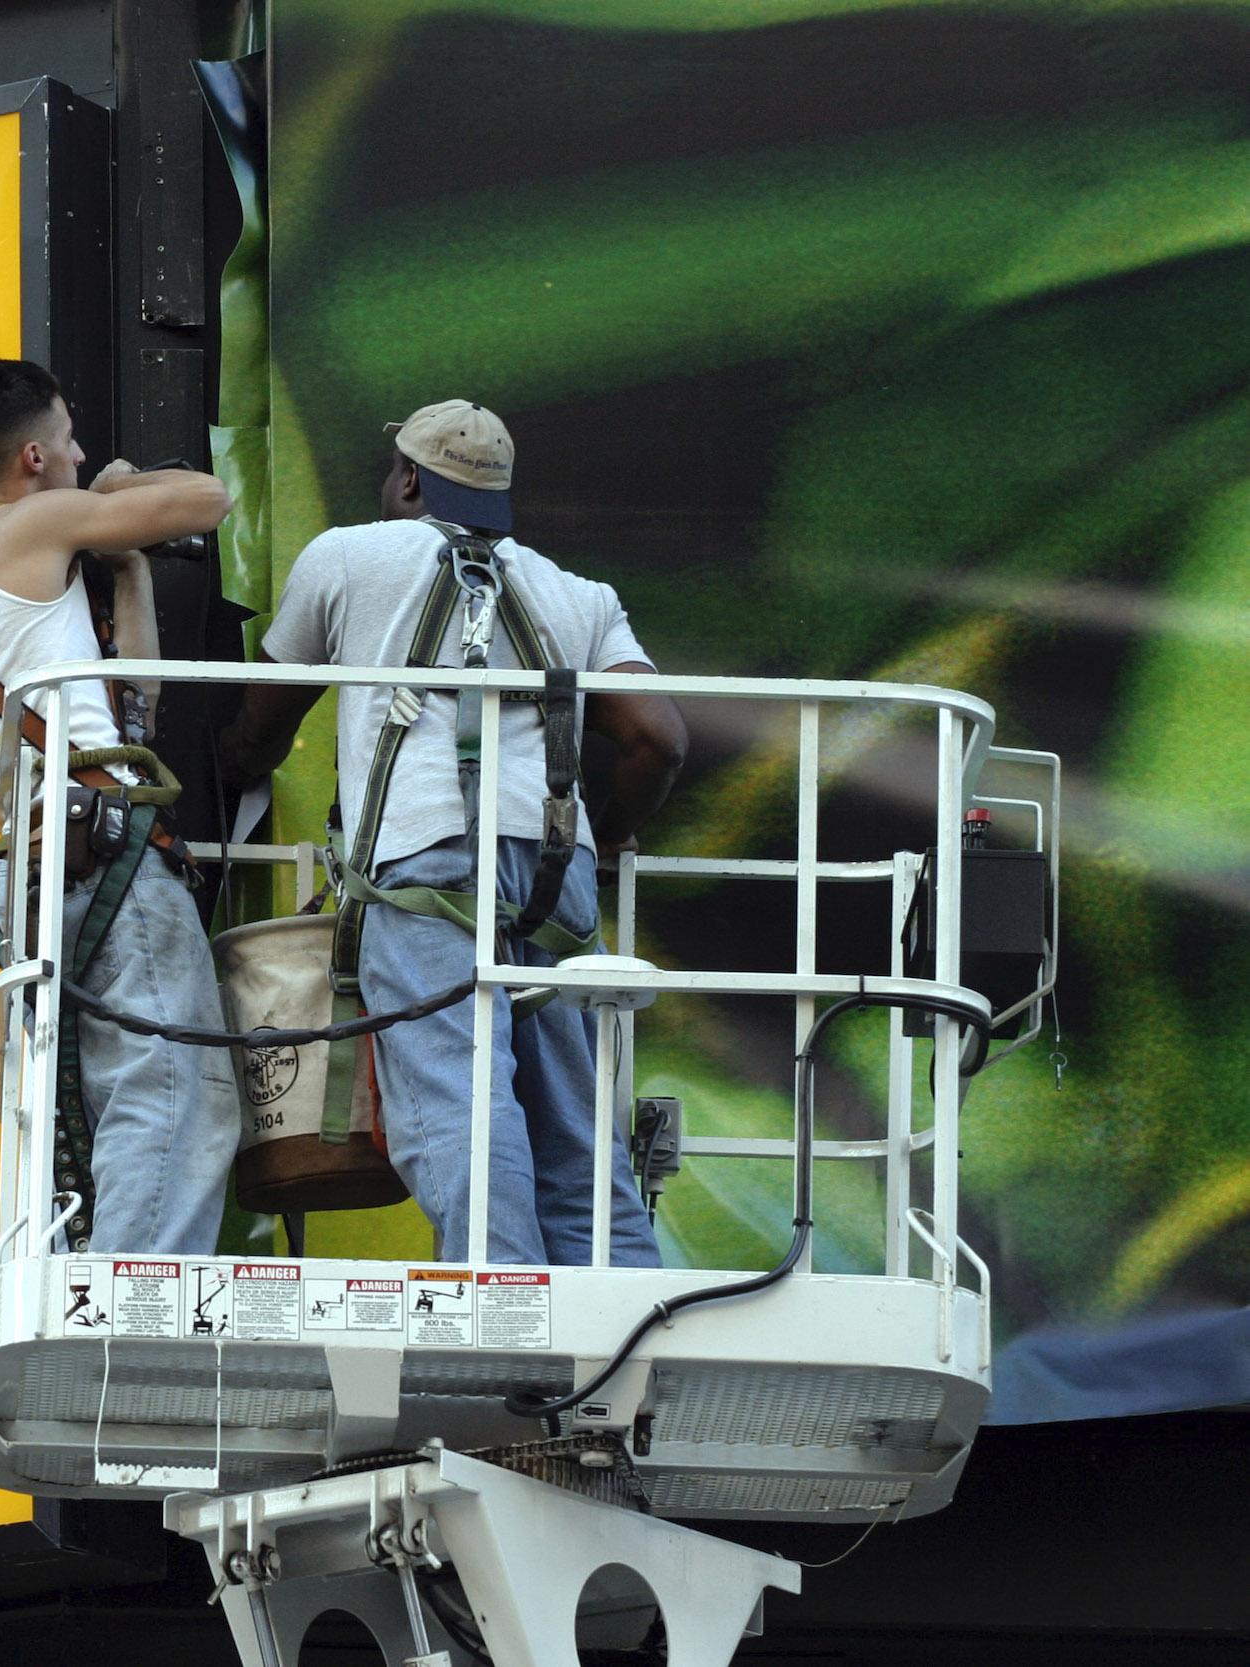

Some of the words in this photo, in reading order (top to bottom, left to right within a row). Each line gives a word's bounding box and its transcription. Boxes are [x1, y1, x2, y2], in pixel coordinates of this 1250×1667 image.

[252, 1084, 283, 1101] TOOLS
[254, 1112, 284, 1132] 5104
[130, 1264, 176, 1277] DANGER
[251, 1267, 297, 1279] DANGER
[500, 1275, 538, 1283] DANGER
[361, 1281, 401, 1291] DANGER
